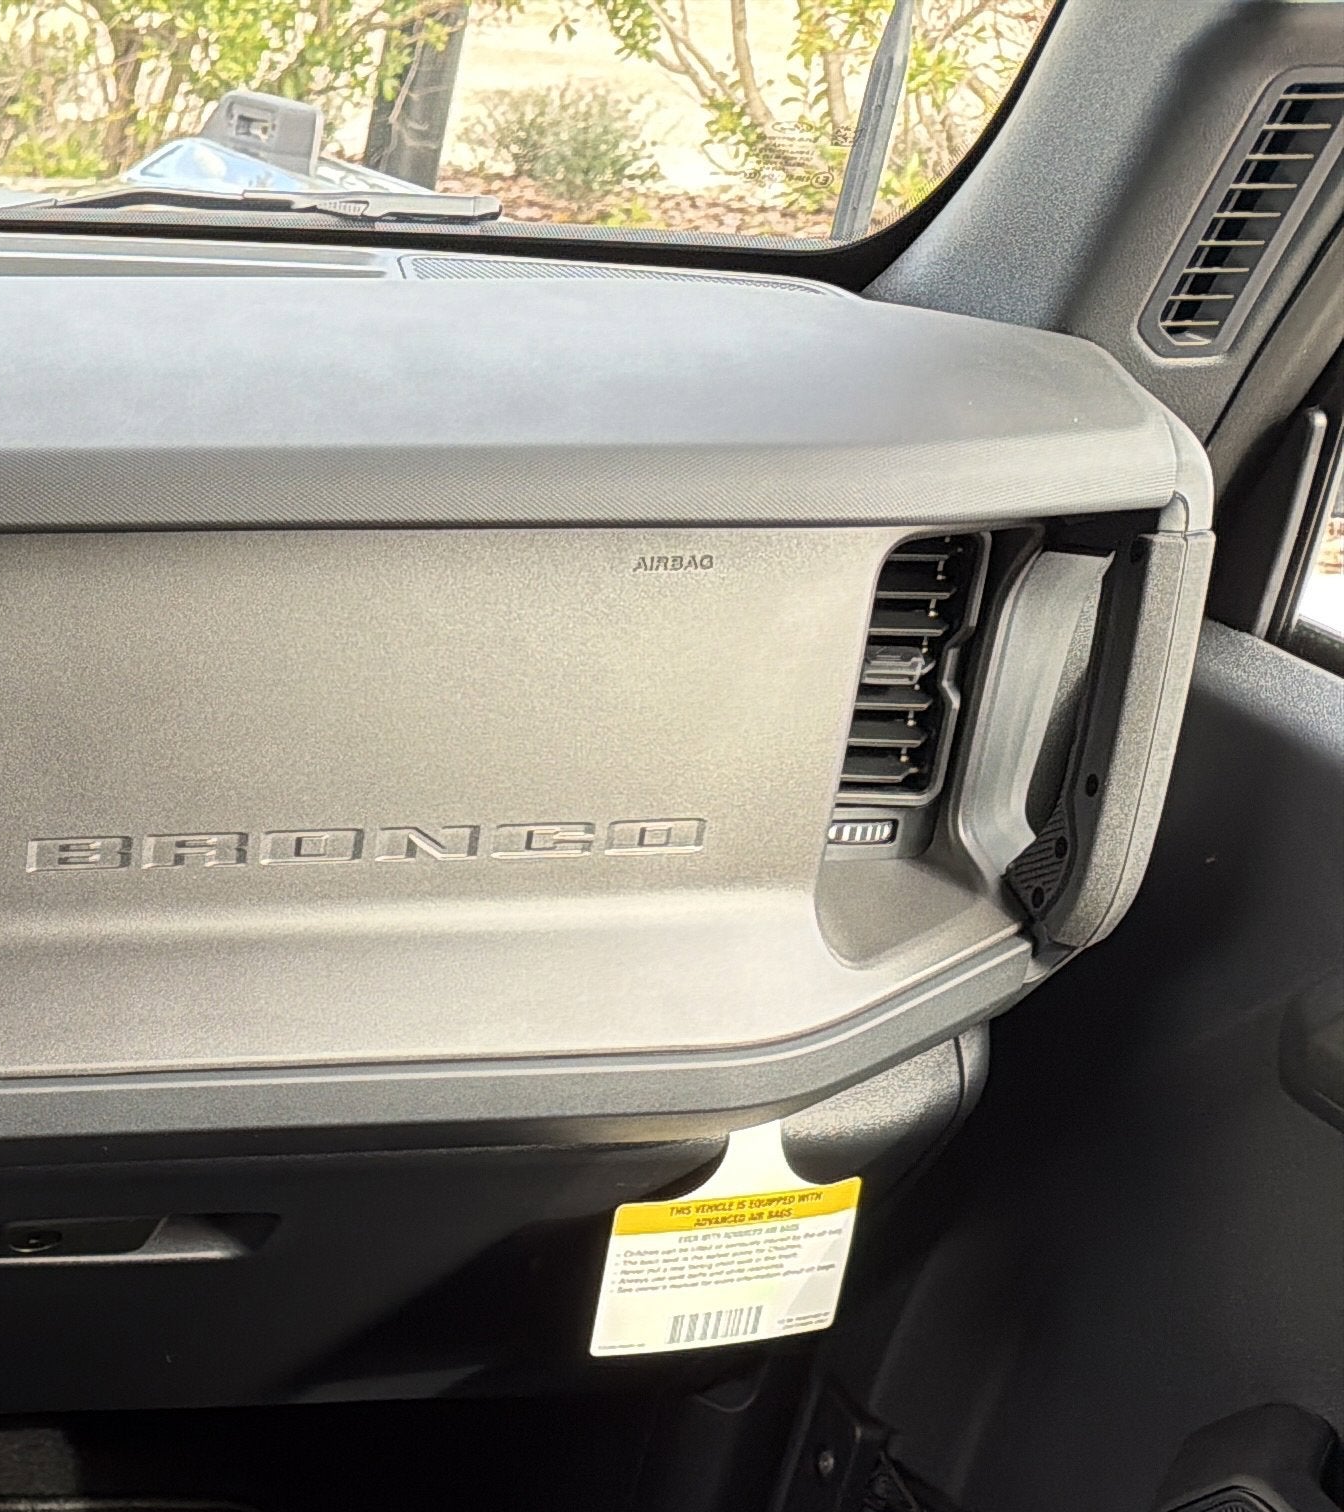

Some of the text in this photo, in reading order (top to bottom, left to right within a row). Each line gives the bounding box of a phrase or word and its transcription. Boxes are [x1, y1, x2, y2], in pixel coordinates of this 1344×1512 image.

[632, 555, 714, 573] AIRBAG
[26, 818, 707, 873] BRONCO
[669, 1192, 824, 1217] THIS VEHICLE IS EQUIPPED WITH
[767, 1208, 793, 1219] BAGS
